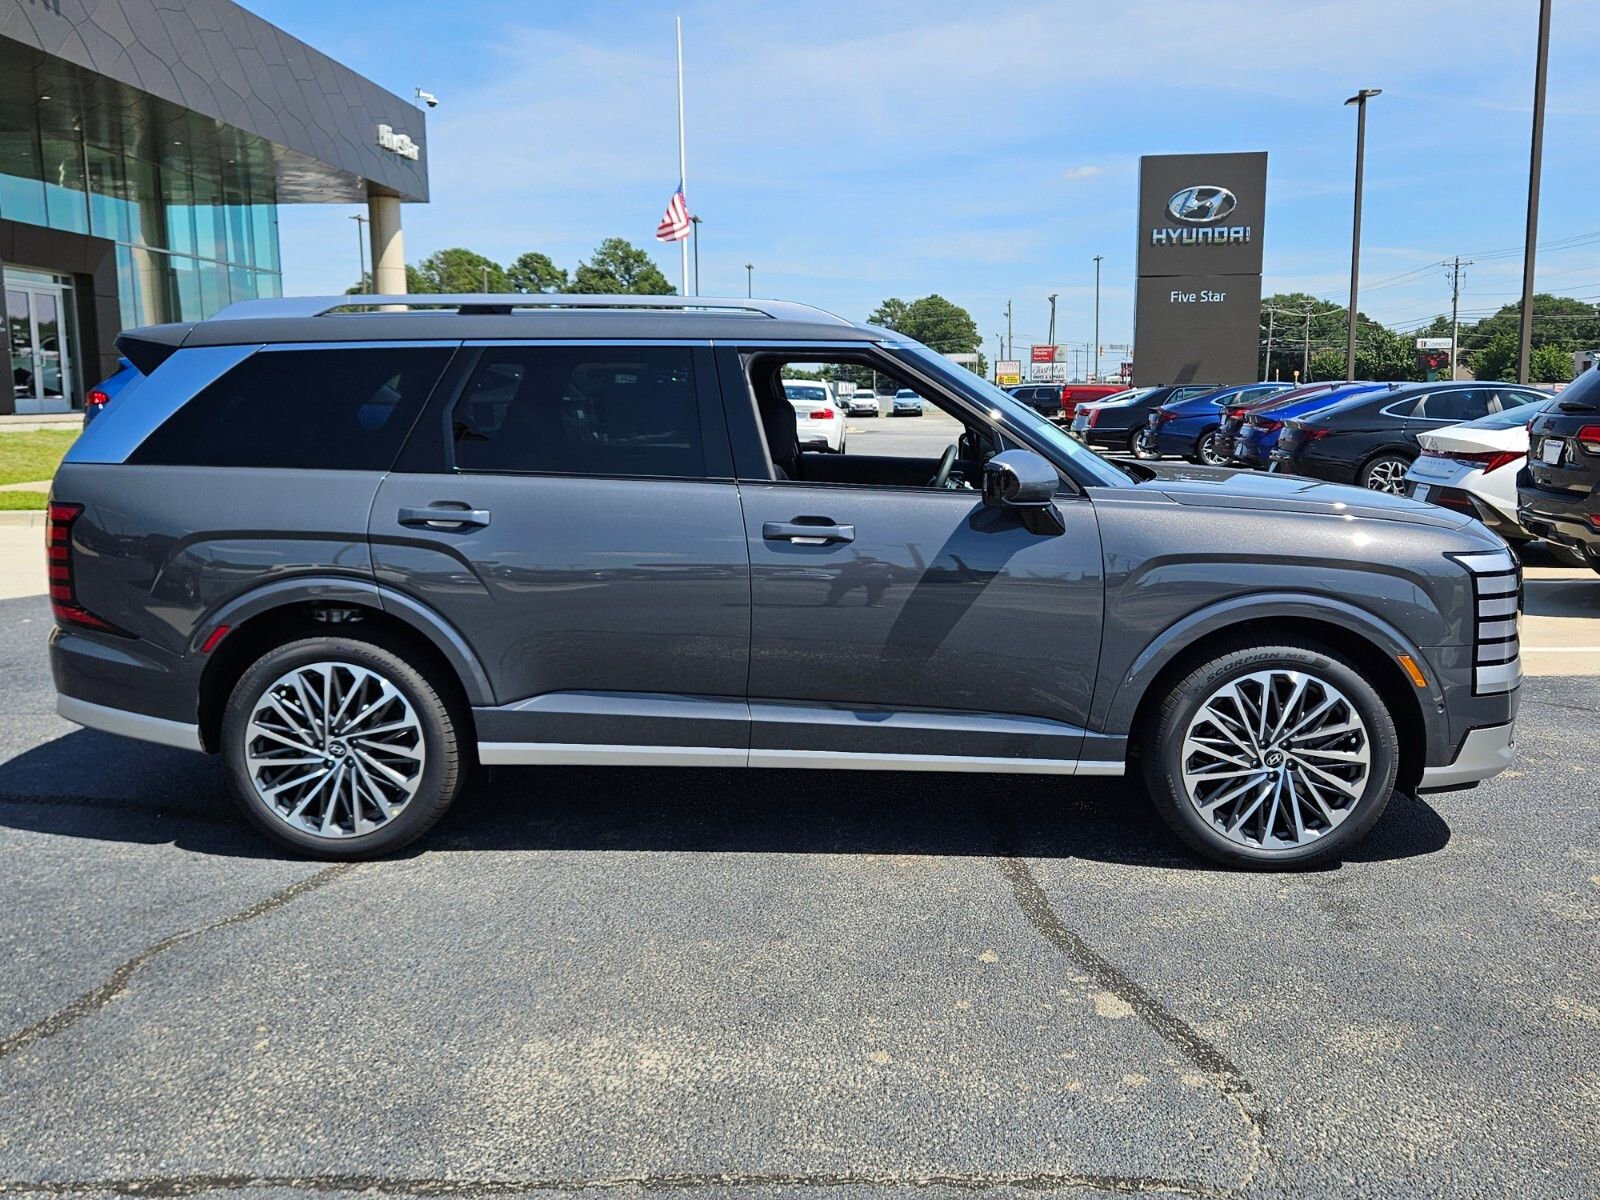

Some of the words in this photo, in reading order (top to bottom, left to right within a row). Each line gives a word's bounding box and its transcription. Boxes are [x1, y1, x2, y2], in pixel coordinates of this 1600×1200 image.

[1152, 226, 1251, 245] HYUNDAI
[1170, 290, 1196, 303] Five
[1200, 290, 1226, 303] Star
[1206, 652, 1280, 684] SCORPION
[1285, 651, 1307, 660] MS
